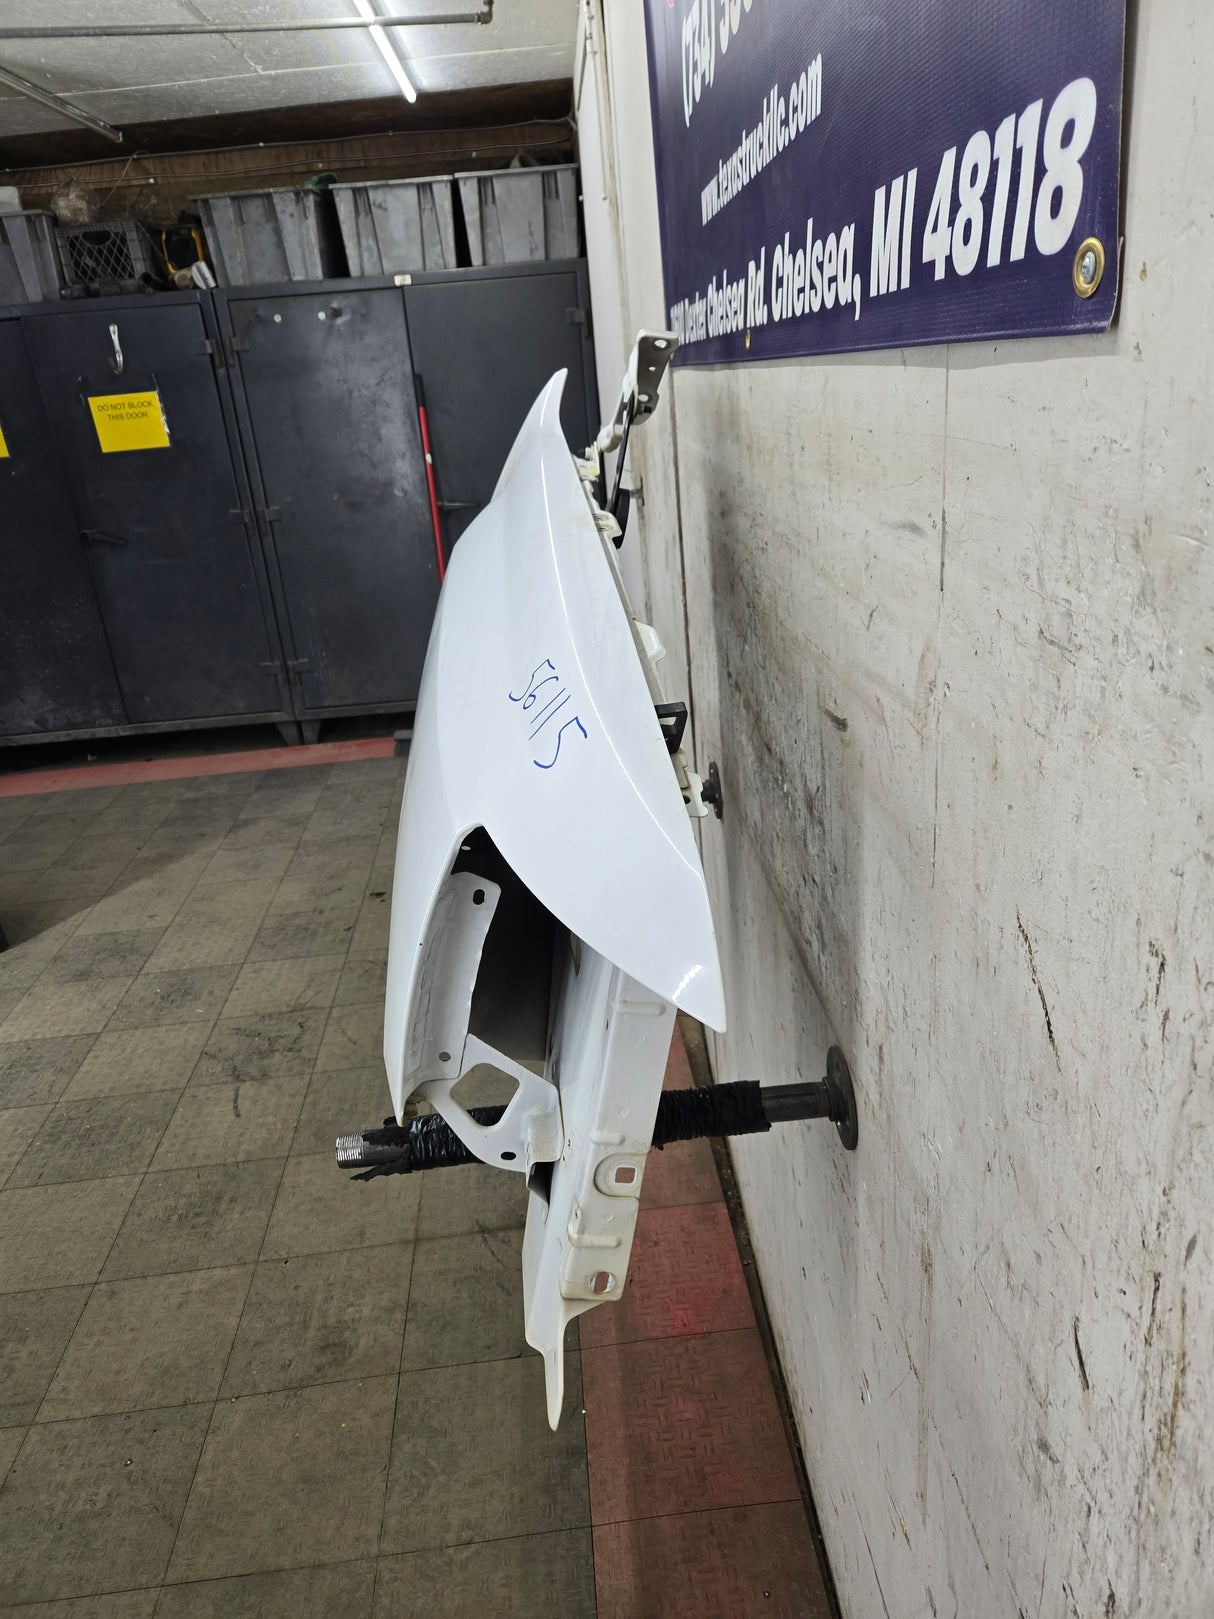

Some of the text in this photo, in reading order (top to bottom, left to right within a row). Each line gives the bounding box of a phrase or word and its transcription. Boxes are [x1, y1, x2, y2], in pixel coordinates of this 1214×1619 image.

[682, 0, 716, 128] (734)
[701, 53, 822, 227] www.texastruckllc.com
[707, 269, 745, 338] Chelsea
[746, 246, 768, 329] Rd.
[771, 217, 861, 321] Chelsea,
[870, 167, 918, 298] MI
[922, 77, 1097, 282] 48118
[97, 400, 153, 412] DO NOT BLOCK
[107, 411, 148, 421] THIS DOOR
[508, 658, 588, 769] 56115
